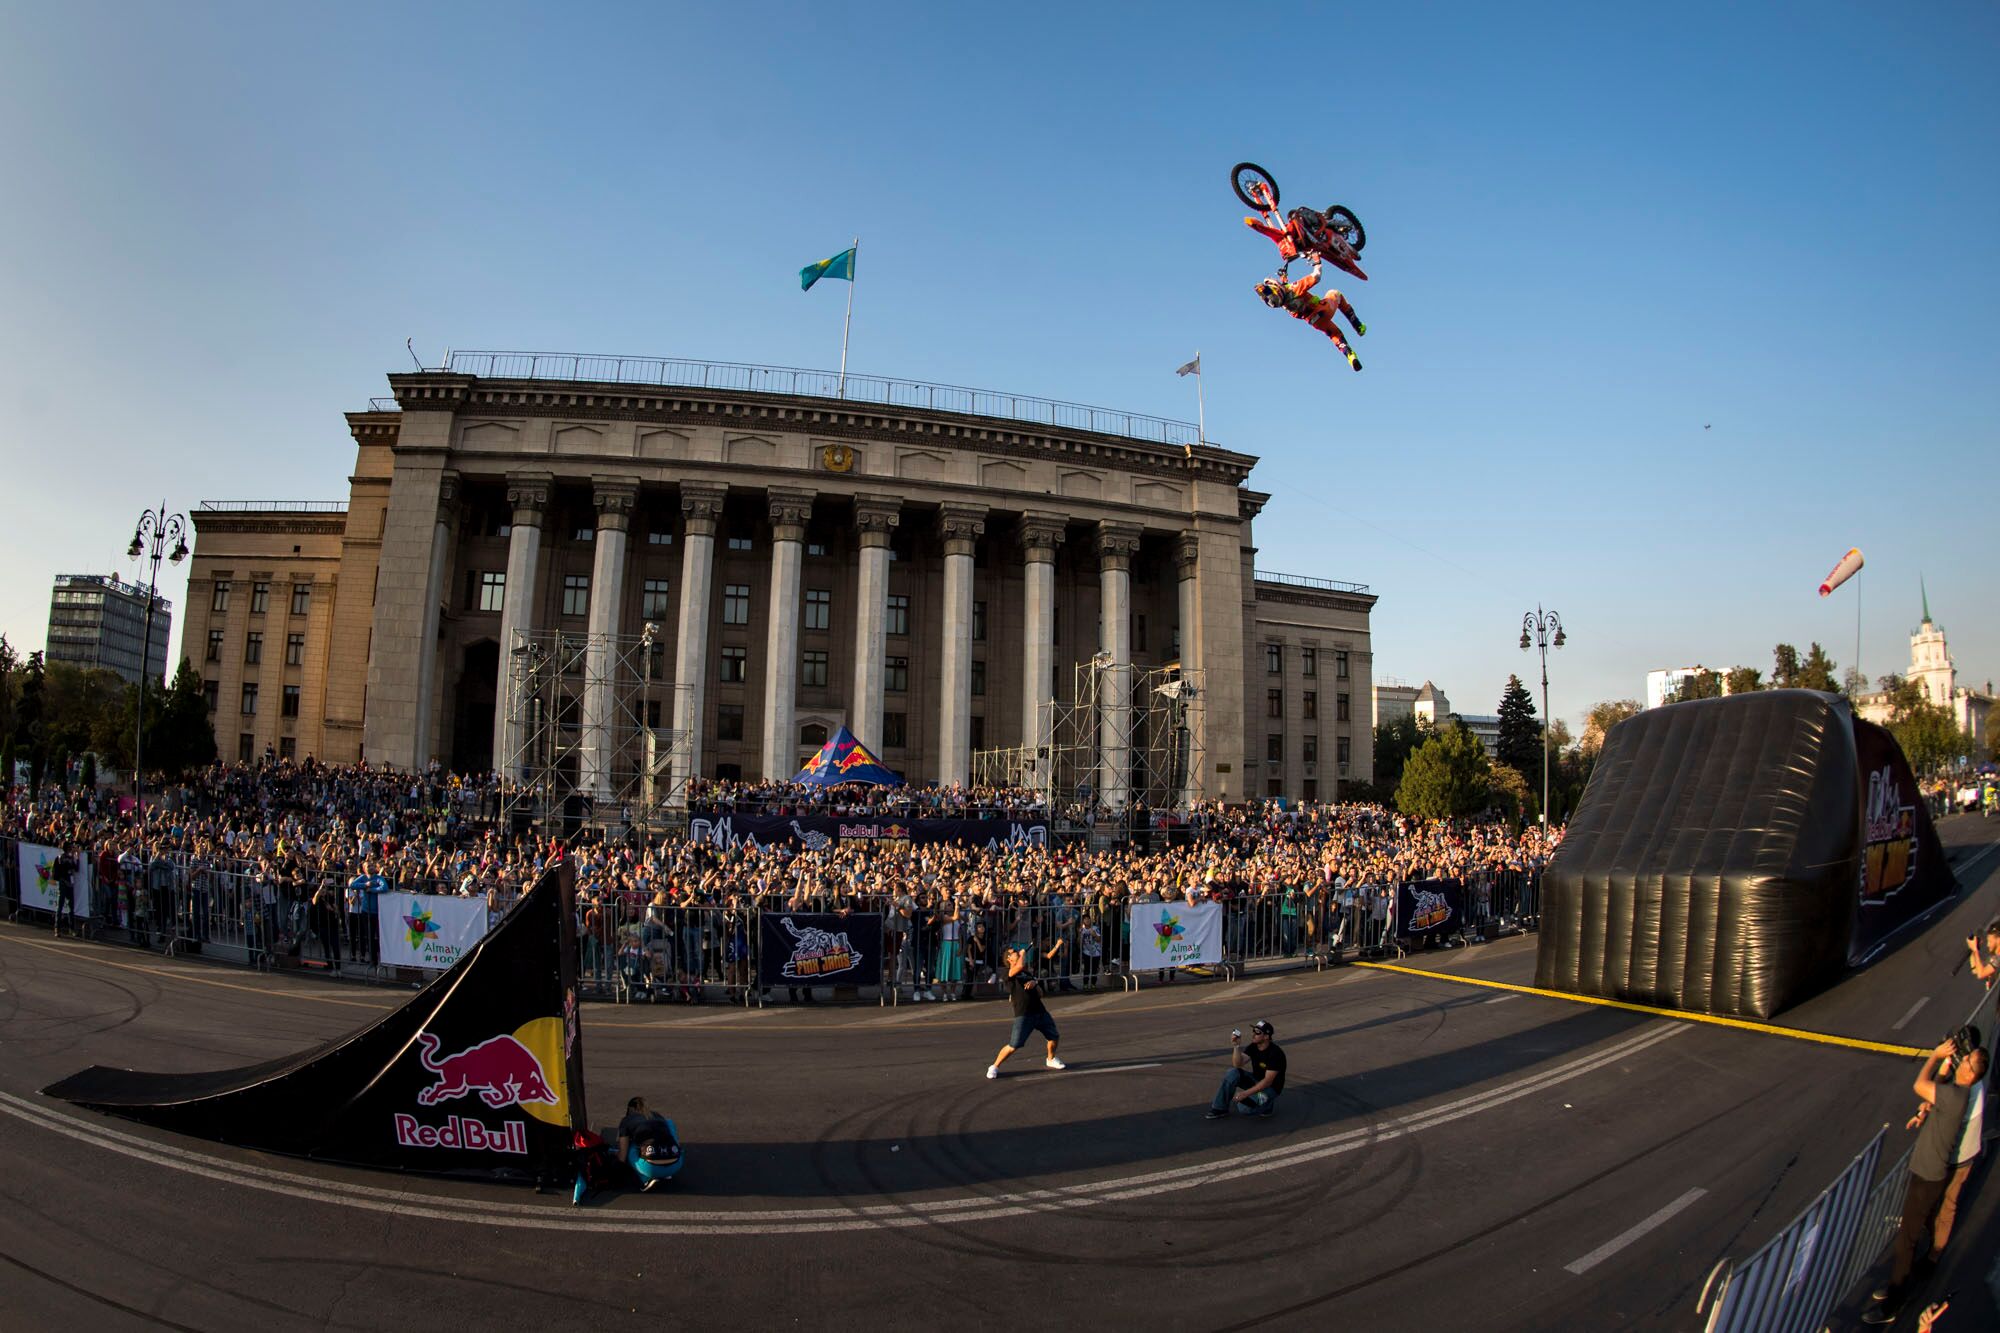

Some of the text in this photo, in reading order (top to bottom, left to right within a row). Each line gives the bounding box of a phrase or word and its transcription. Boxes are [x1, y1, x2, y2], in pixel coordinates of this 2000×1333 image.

[840, 824, 878, 837] Red Bull
[424, 943, 461, 956] Almaty
[1171, 943, 1200, 953] Almaty
[394, 1113, 528, 1154] Red Bull
